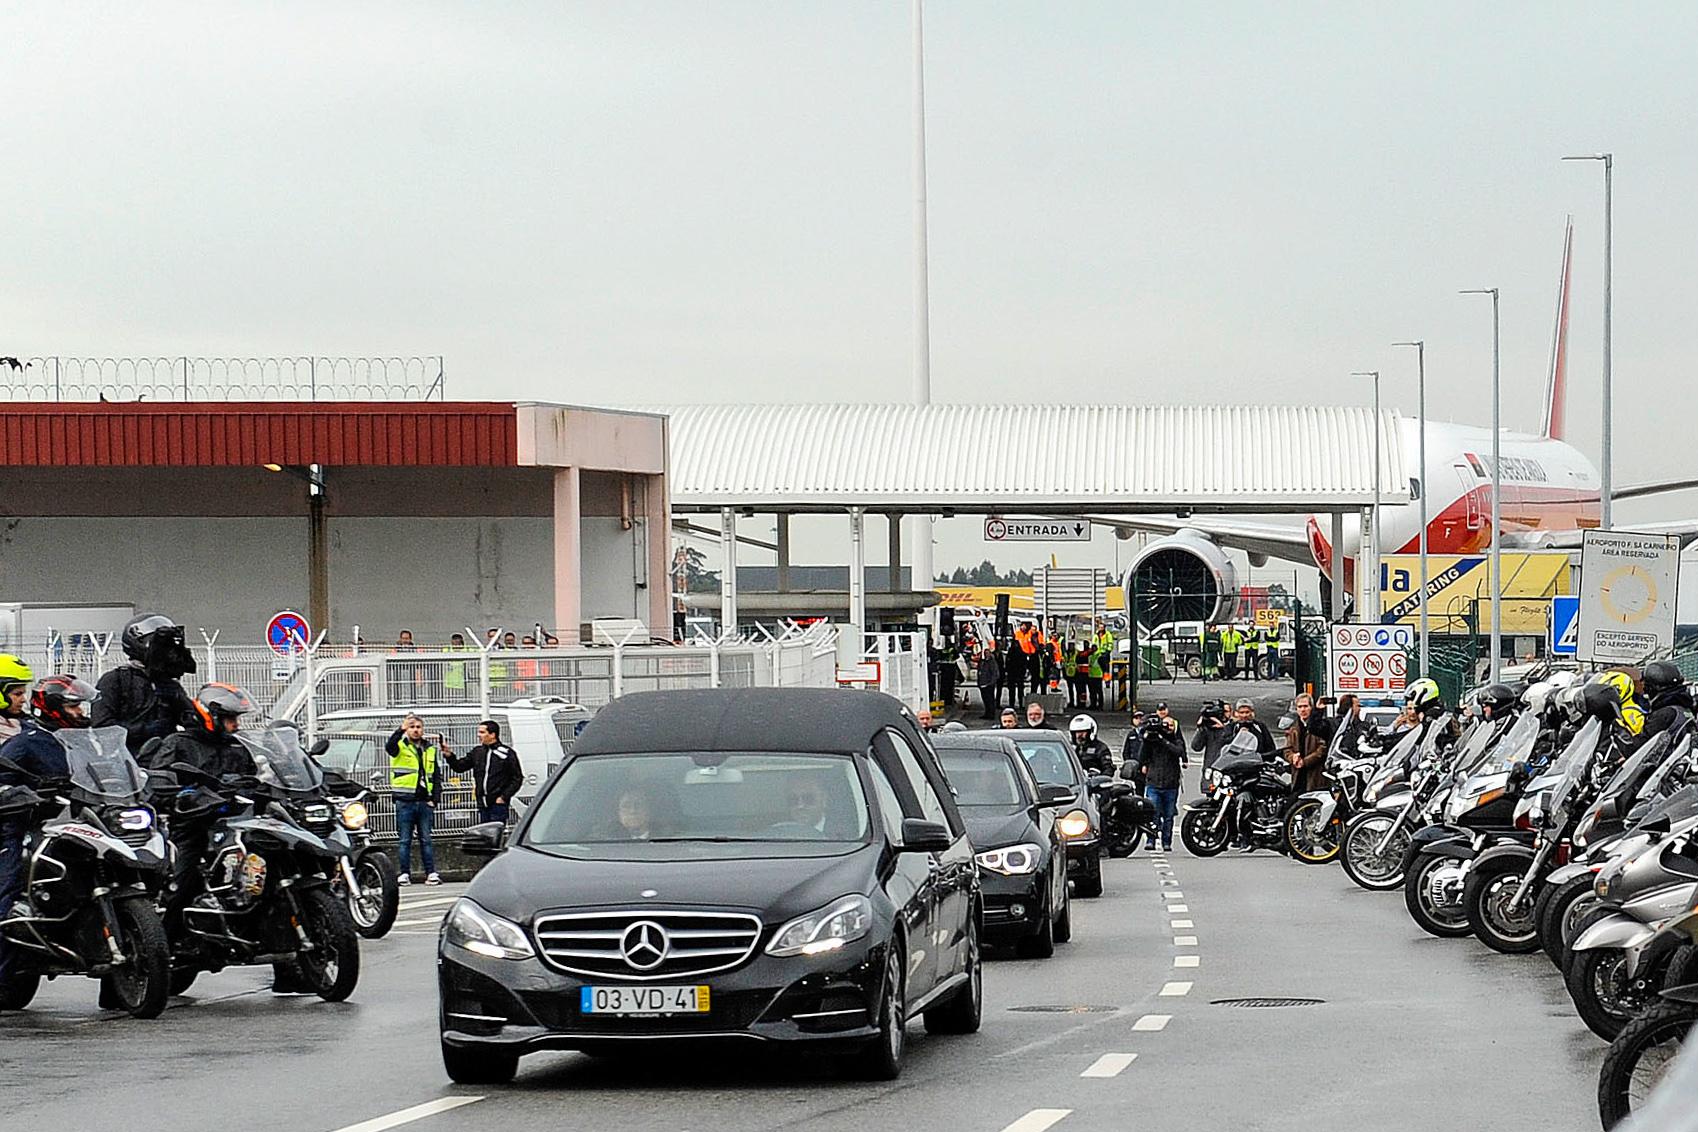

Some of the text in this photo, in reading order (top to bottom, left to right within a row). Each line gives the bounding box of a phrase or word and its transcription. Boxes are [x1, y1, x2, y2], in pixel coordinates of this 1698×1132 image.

[1007, 525, 1067, 535] ENTRADA
[1586, 539, 1626, 548] AEROPORTO
[1621, 550, 1659, 559] RESERVADA
[1393, 567, 1460, 617] CATRING
[1596, 633, 1626, 641] EXCEPTO
[1608, 641, 1649, 649] AEROPORTO
